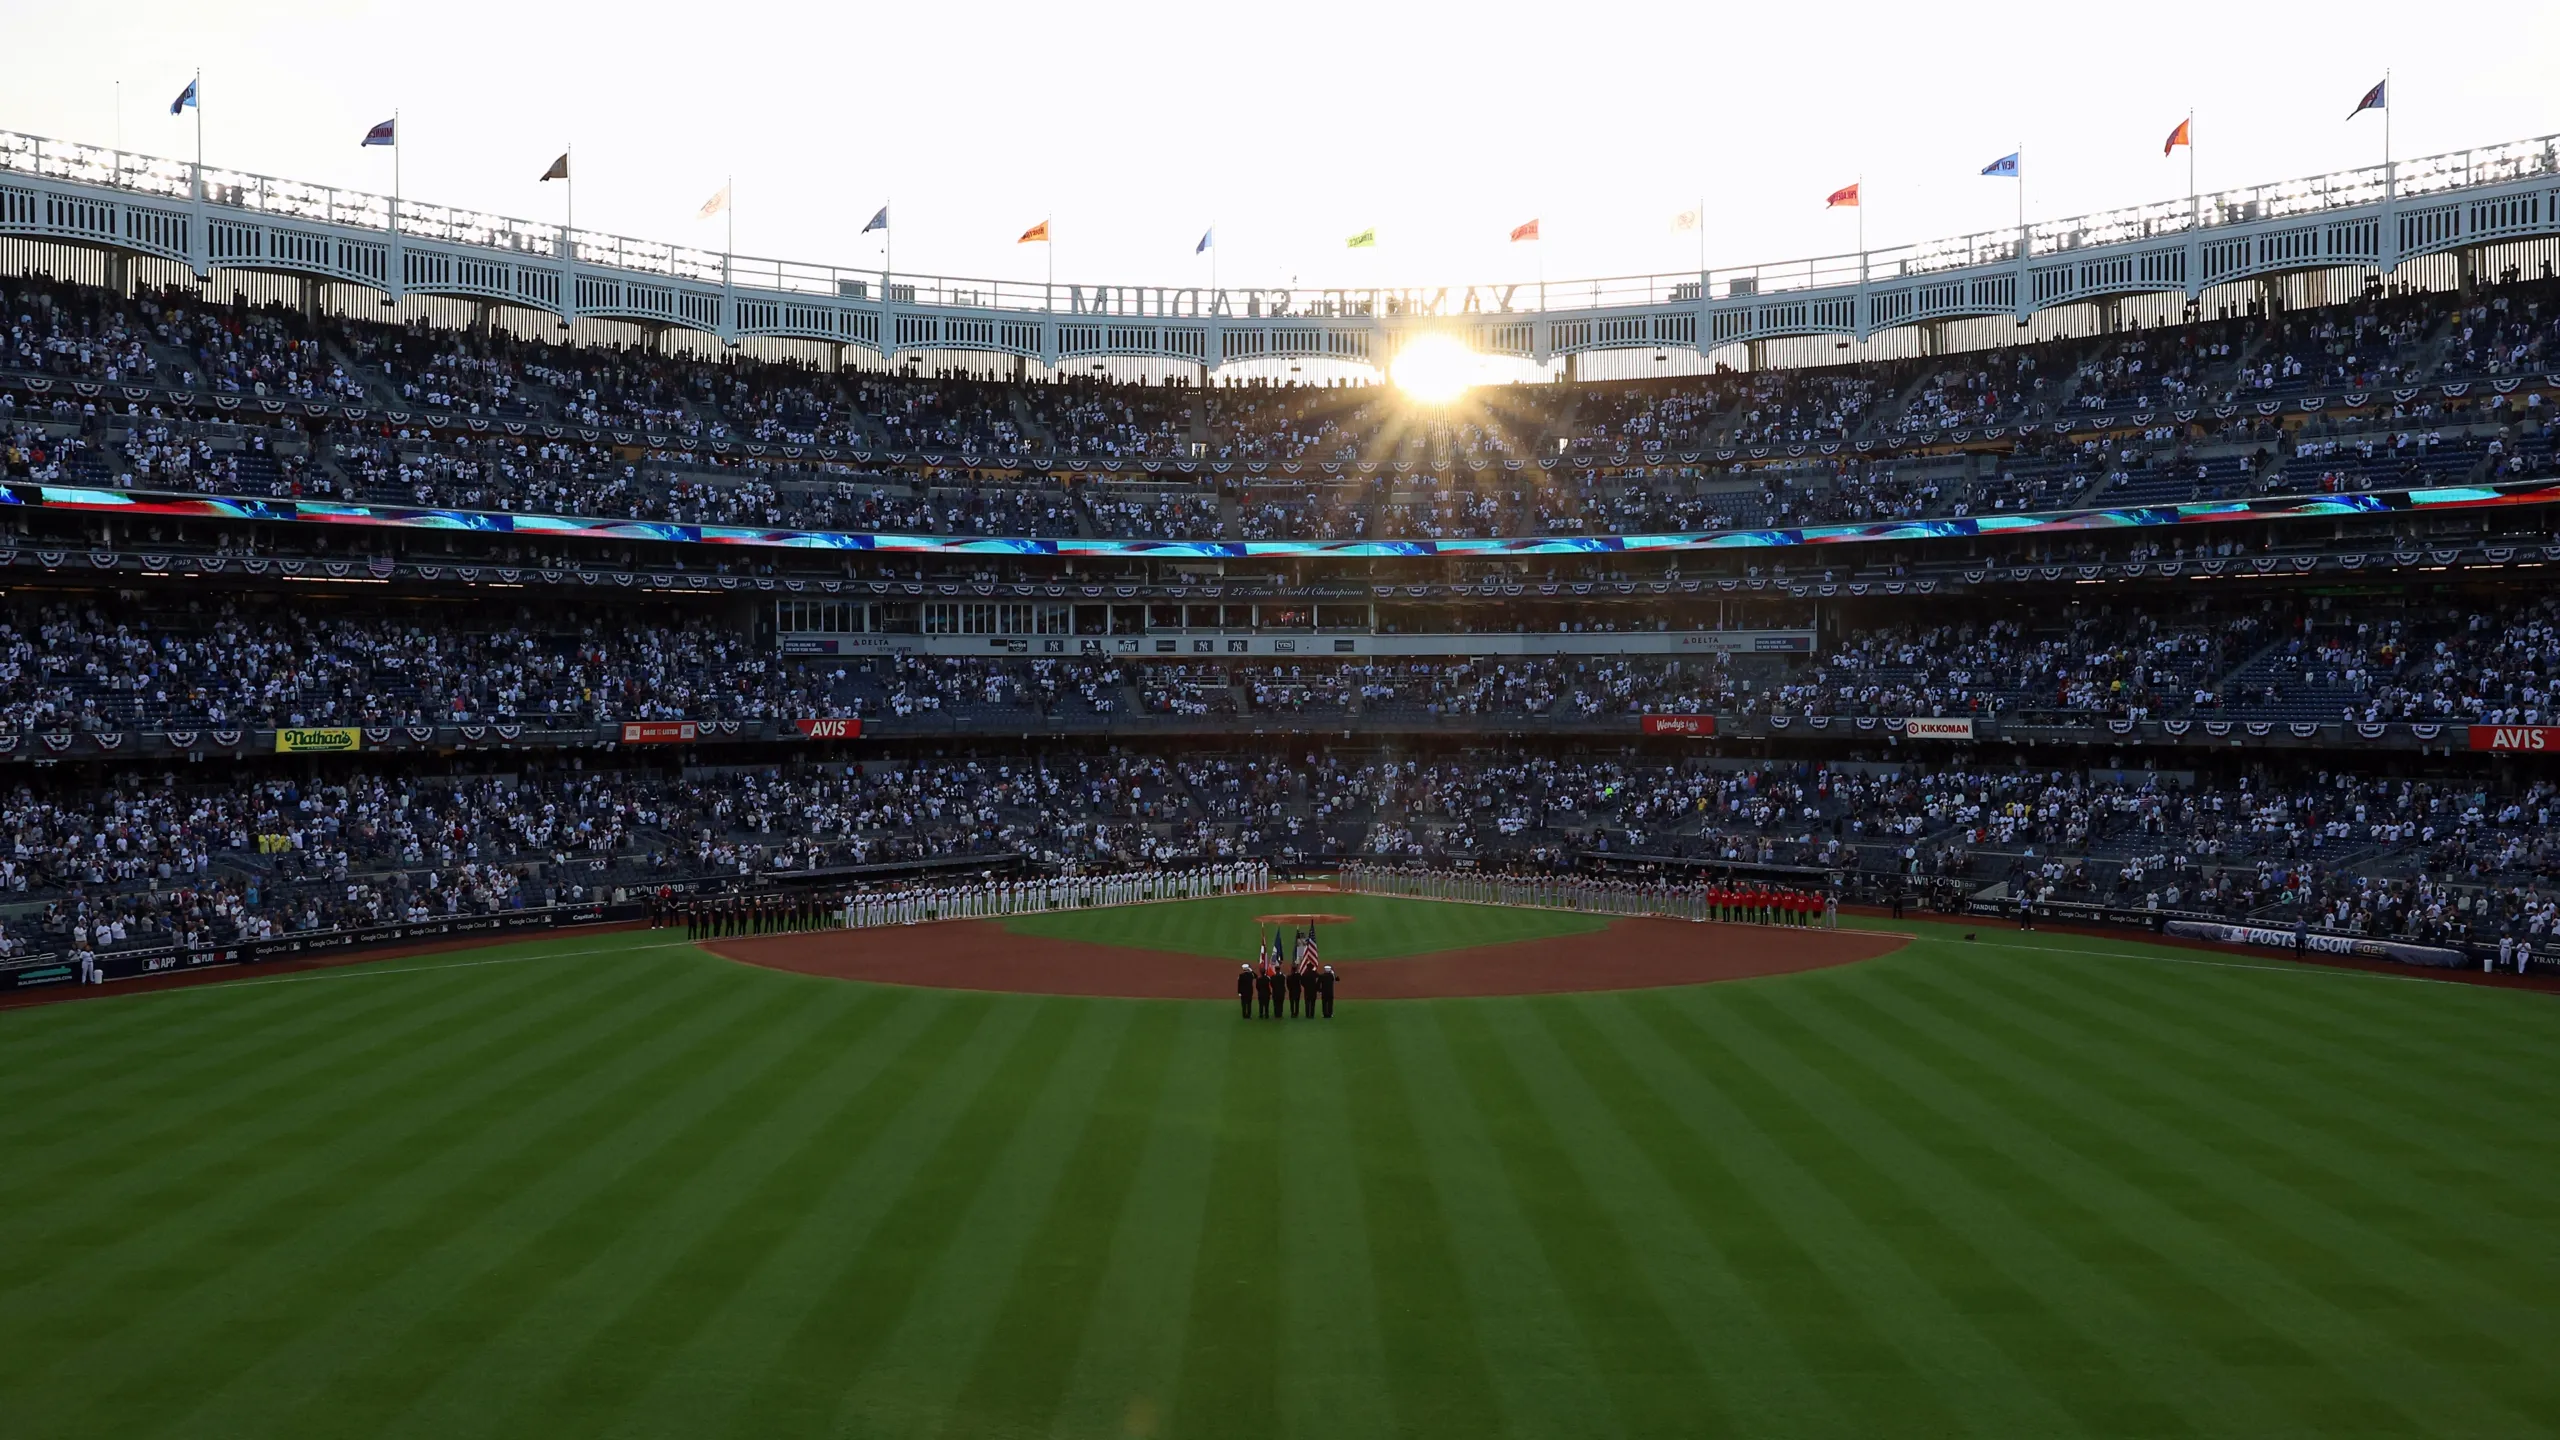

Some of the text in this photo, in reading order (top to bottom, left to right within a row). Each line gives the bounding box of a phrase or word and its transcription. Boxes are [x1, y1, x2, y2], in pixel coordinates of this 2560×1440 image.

[1231, 586, 1364, 599] 27-Time World Champions
[1119, 641, 1137, 652] WFAN
[810, 720, 846, 737] AVIS
[1656, 718, 1685, 732] Wendy's
[1921, 723, 1969, 734] KIKKOMAN
[285, 730, 353, 747] Nathan's
[2492, 728, 2545, 749] AVIS
[1972, 903, 2000, 912] FANDUEL
[525, 916, 539, 924] Cloud
[2058, 910, 2087, 919] Google Cloud
[2109, 914, 2126, 922] Google
[360, 932, 389, 942] Google Cloud
[409, 928, 425, 936] Google
[309, 938, 339, 948] Google Cloud
[2248, 928, 2354, 954] POSTSASON
[255, 944, 287, 954] Google Cloud
[201, 950, 238, 963] PLAY.ORG
[160, 956, 176, 969] APP
